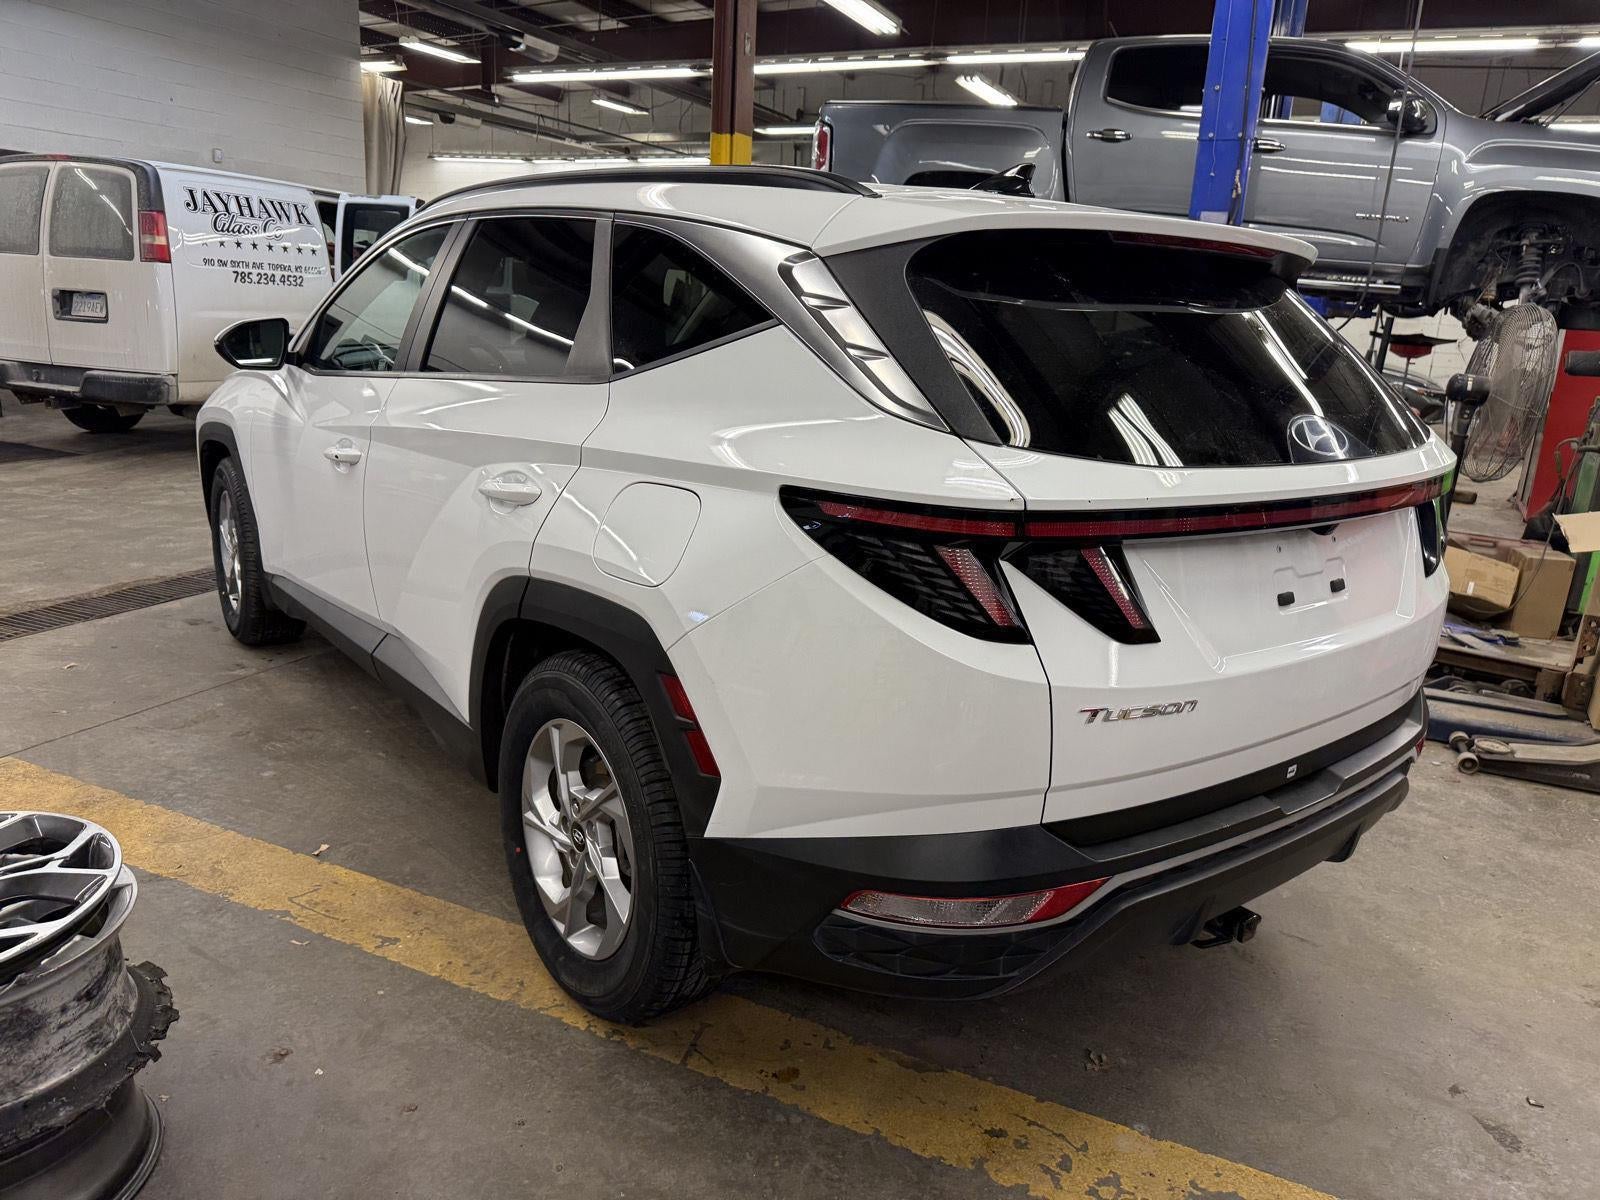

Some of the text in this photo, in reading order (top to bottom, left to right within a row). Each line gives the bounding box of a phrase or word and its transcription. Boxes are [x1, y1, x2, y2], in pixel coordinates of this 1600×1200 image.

[183, 186, 313, 227] JAYHAWK
[211, 212, 259, 237] Glass
[202, 257, 215, 267] 910
[217, 258, 229, 268] SW
[230, 259, 250, 270] SIXTH
[251, 261, 265, 270] AVE
[293, 265, 304, 274] KS
[232, 270, 304, 288] 785.234.4532
